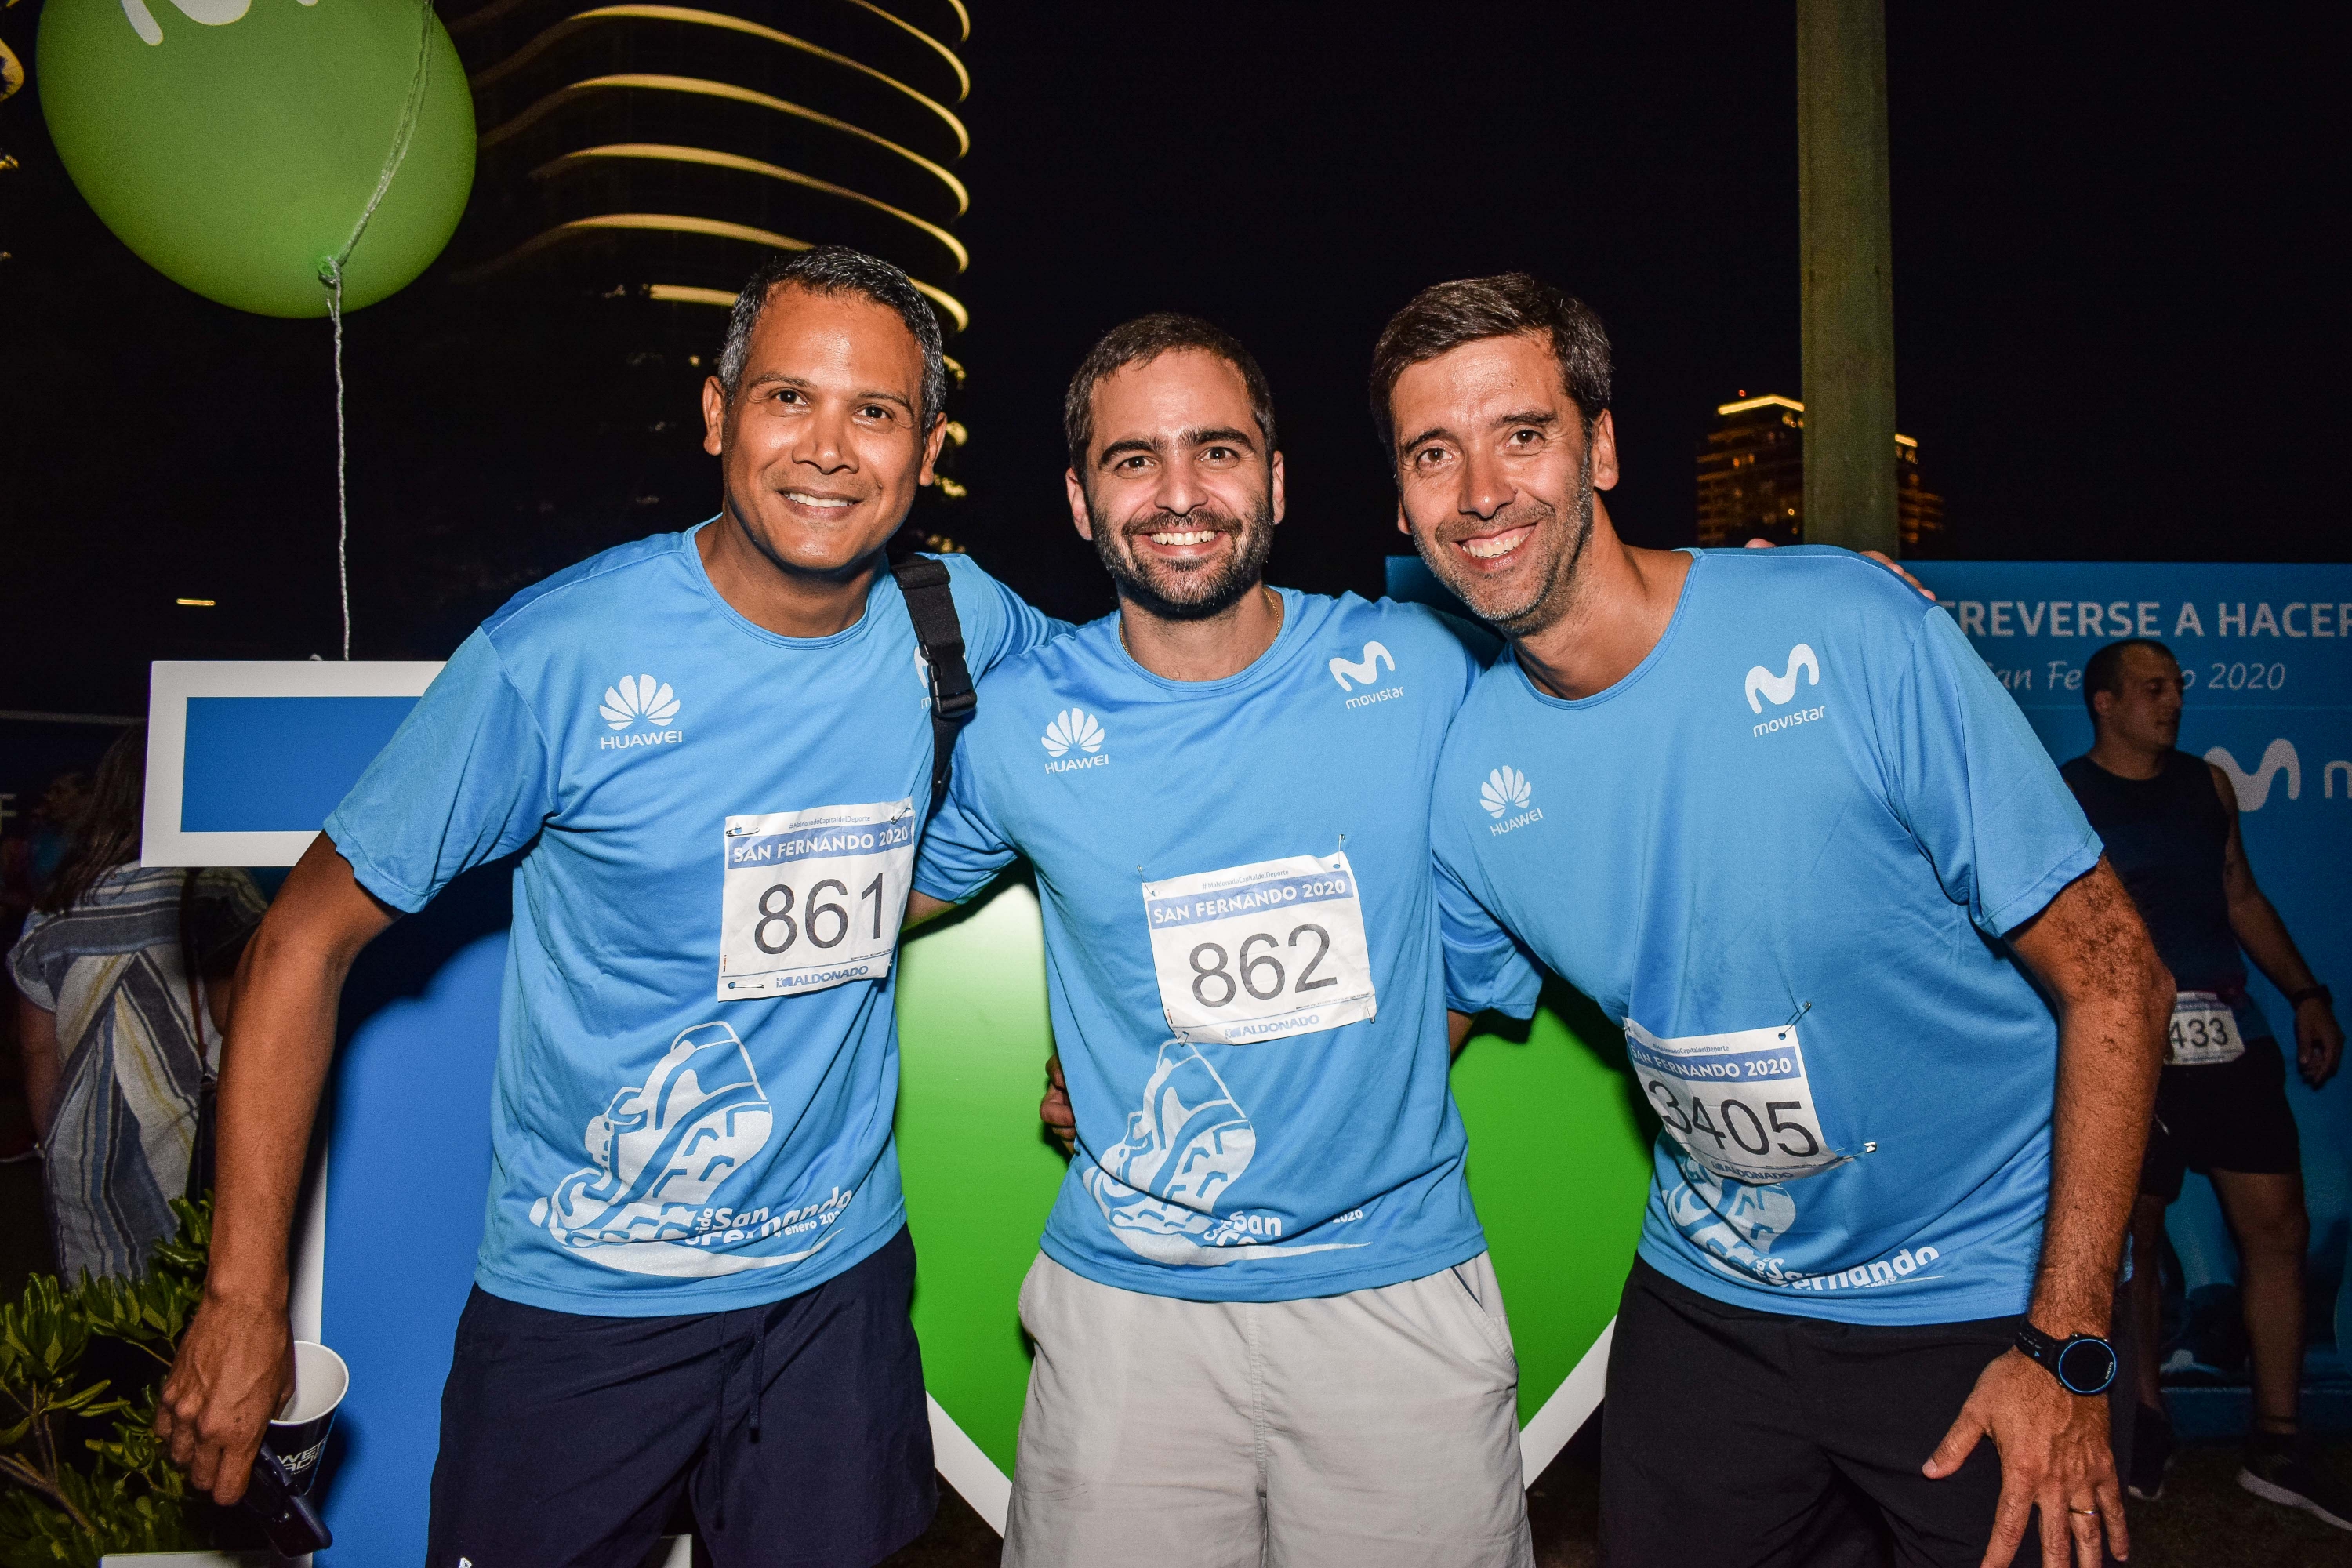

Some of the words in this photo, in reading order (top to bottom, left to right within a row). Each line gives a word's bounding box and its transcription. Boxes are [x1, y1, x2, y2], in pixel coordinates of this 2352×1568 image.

[1938, 601, 2162, 637] REVERSE
[2174, 602, 2205, 637] A
[2208, 662, 2286, 691] 2020
[1345, 684, 1404, 710] movistar
[1753, 705, 1825, 738] movistar
[601, 731, 683, 750] HUAWEI
[1044, 754, 1109, 774] HUAWEI
[1490, 808, 1543, 837] HUAWEI
[733, 844, 771, 863] SAN
[777, 834, 875, 858] FERNANDO
[879, 826, 908, 847] 2020
[754, 872, 884, 955] 861
[1152, 903, 1190, 924] SAN
[1196, 886, 1298, 917] FERNANDO
[1301, 878, 1346, 898] 2020
[1189, 923, 1338, 1008] 862
[1630, 1044, 1651, 1065] SAN
[1653, 1055, 1740, 1078] FERNANDO
[1744, 1057, 1791, 1077] 2020
[1648, 1080, 1820, 1158] 3405
[711, 1207, 769, 1230] San
[785, 1220, 817, 1236] enero
[1229, 1210, 1282, 1236] San
